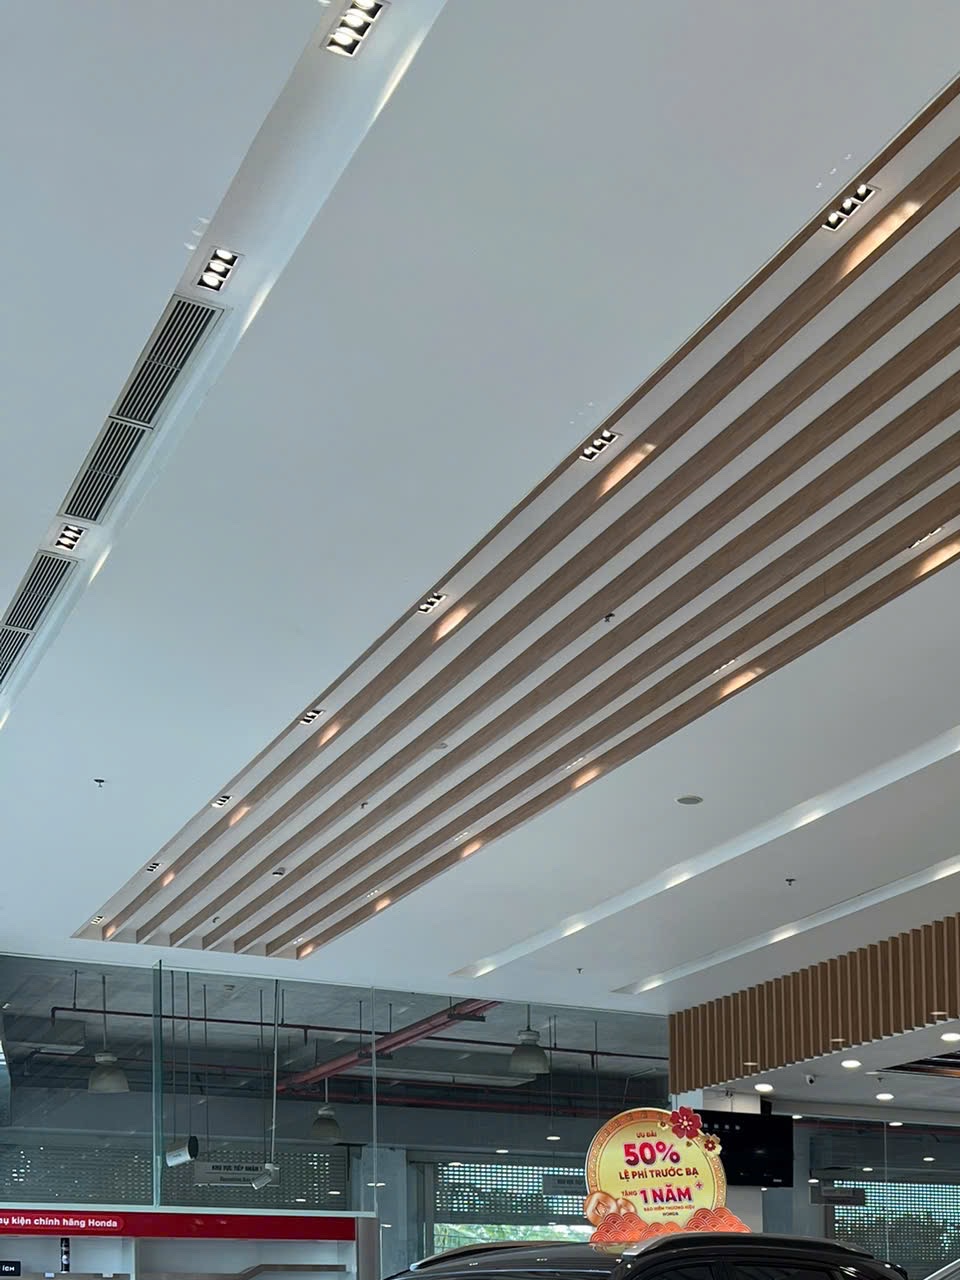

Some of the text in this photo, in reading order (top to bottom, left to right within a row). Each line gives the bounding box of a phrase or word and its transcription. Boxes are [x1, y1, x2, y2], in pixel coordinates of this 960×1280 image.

[623, 1141, 681, 1166] 50%
[619, 1166, 699, 1182] LỆ PHÍ TRƯỚC BẠ
[640, 1190, 648, 1204] 1
[652, 1184, 692, 1203] NĂM
[12, 1217, 31, 1226] kiện
[34, 1217, 60, 1226] chính
[88, 1219, 118, 1228] Honda
